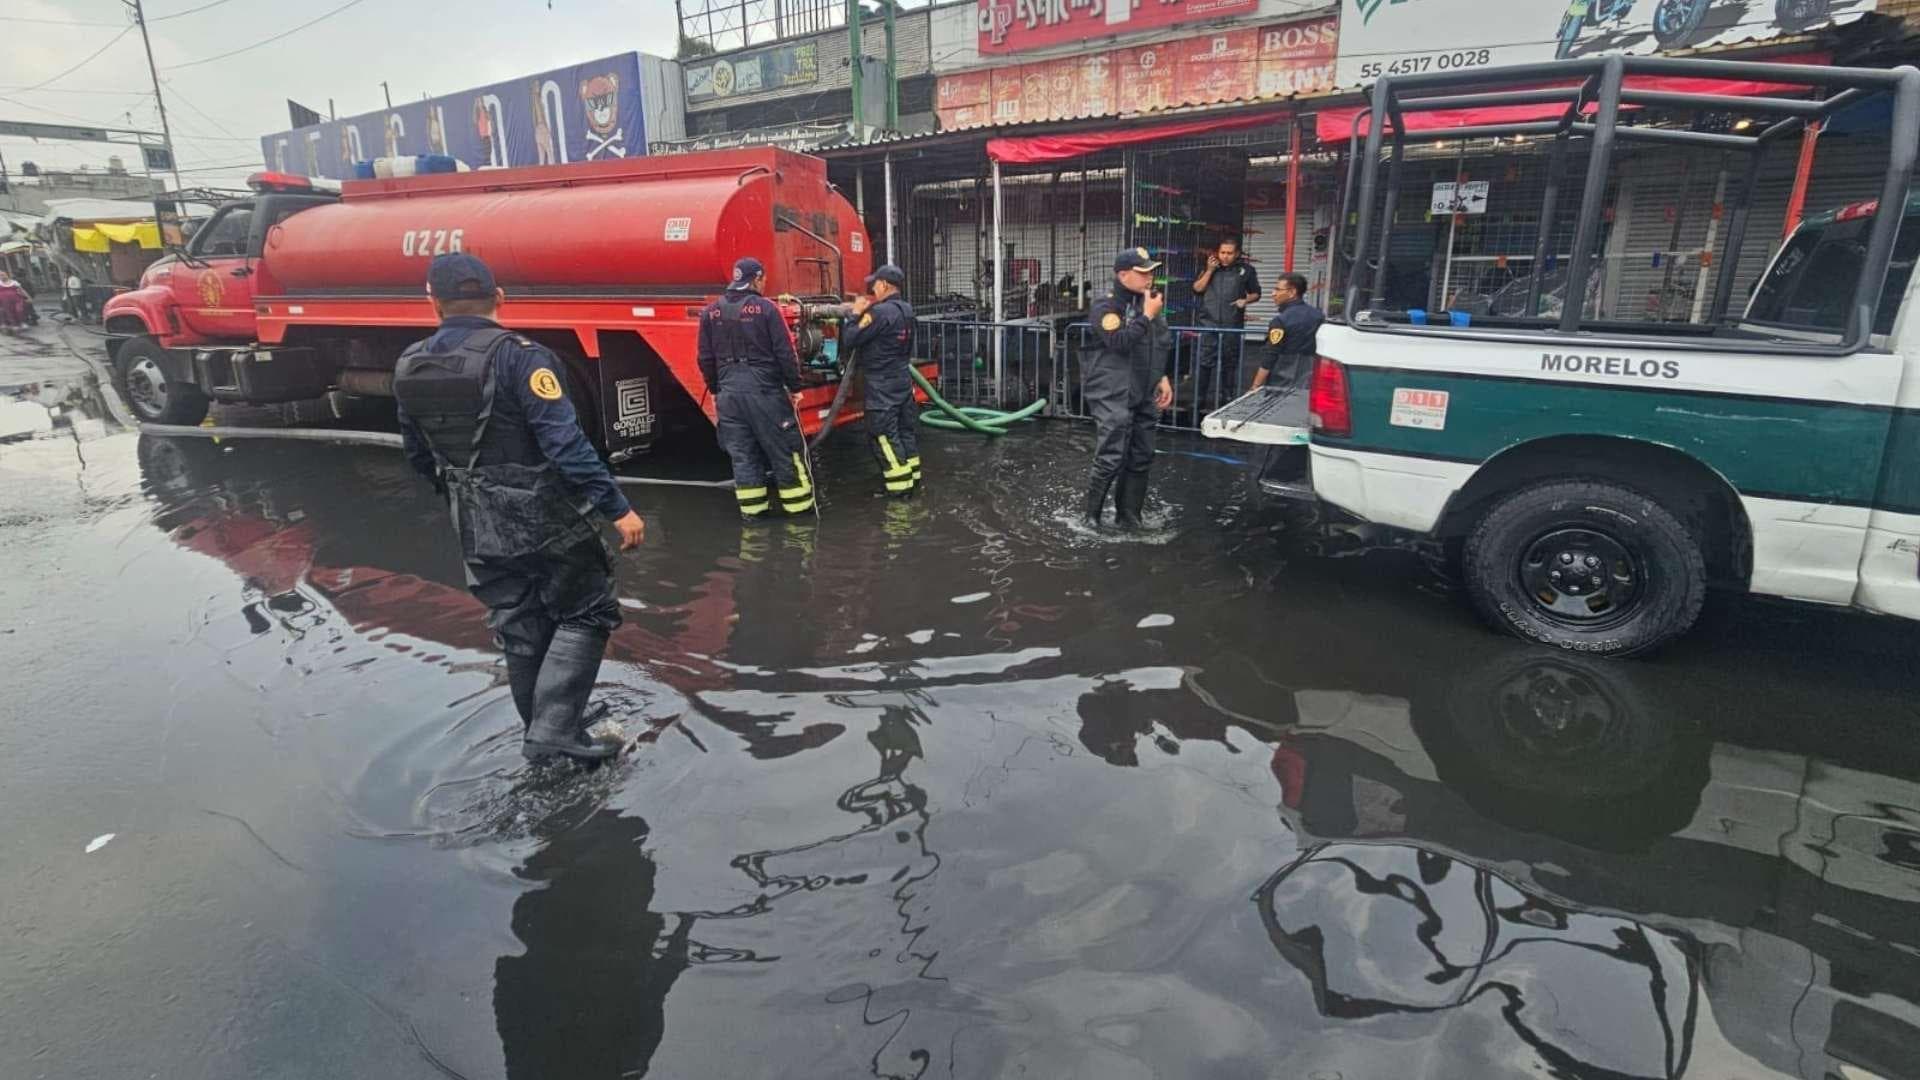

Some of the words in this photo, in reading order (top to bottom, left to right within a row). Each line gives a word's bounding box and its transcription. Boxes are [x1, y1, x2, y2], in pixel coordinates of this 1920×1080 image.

[1264, 22, 1336, 51] BOSS
[1360, 63, 1382, 79] 55
[1387, 56, 1432, 75] 4517
[1437, 50, 1490, 70] 0028
[403, 228, 464, 256] 0226
[1540, 353, 1680, 379] MORELOS
